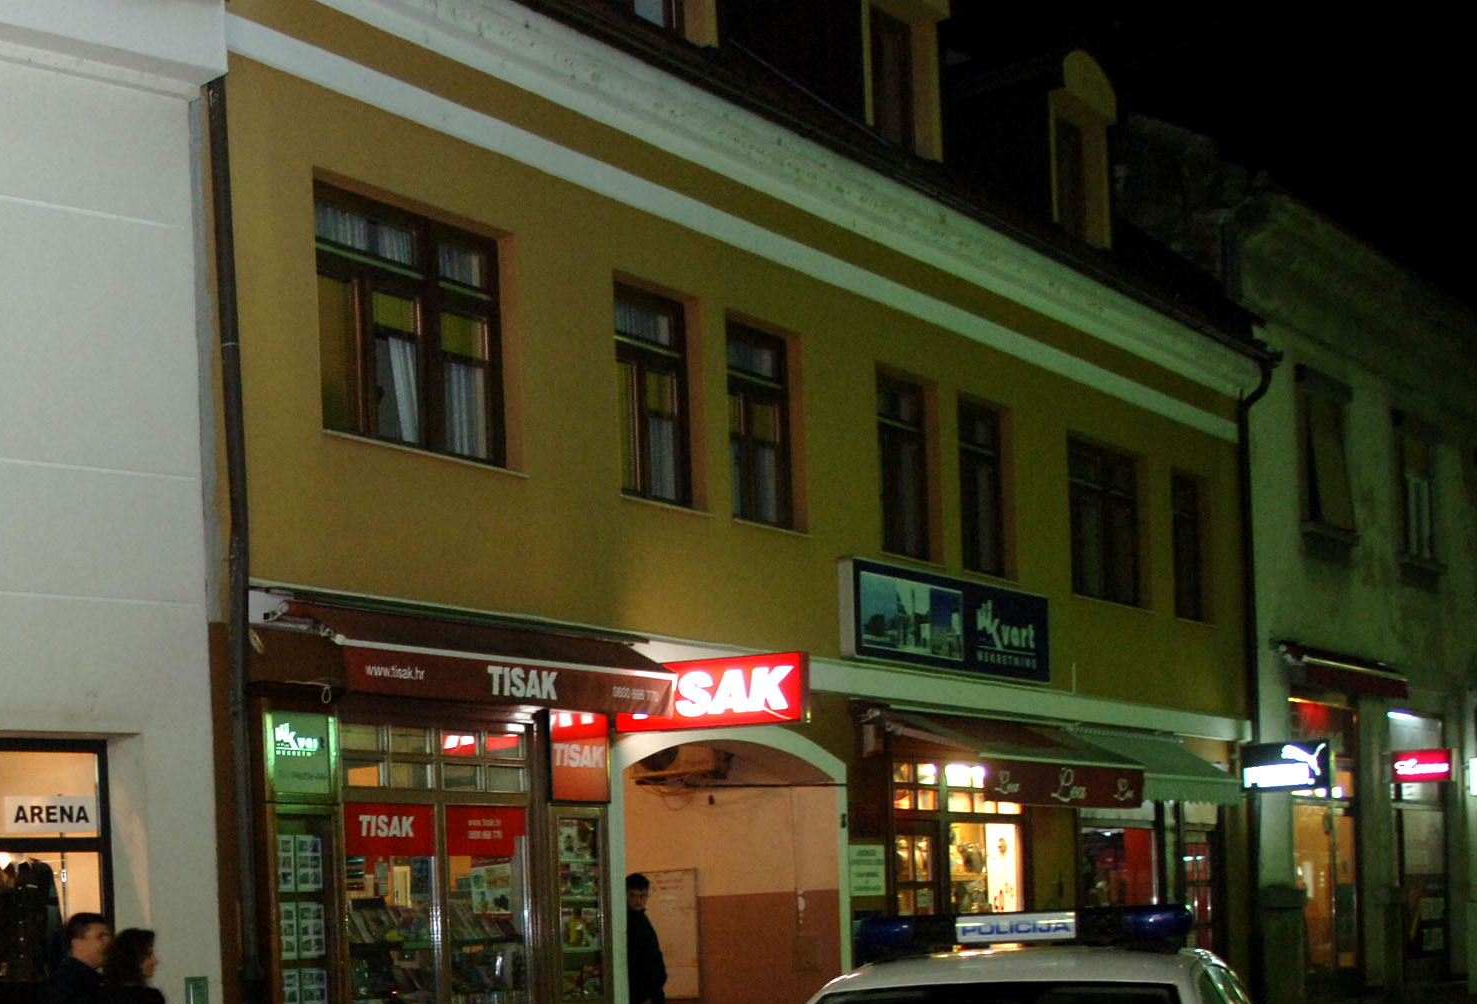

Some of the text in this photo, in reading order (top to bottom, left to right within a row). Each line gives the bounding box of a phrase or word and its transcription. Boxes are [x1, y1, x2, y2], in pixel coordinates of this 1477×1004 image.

[365, 665, 425, 680] www.tisak.hr
[487, 666, 557, 700] TISAK
[672, 665, 794, 718] SAK
[554, 743, 605, 768] TISAK
[14, 805, 90, 824] ARENA
[358, 814, 415, 838] TISAK
[961, 920, 1071, 936] POLICIJA
